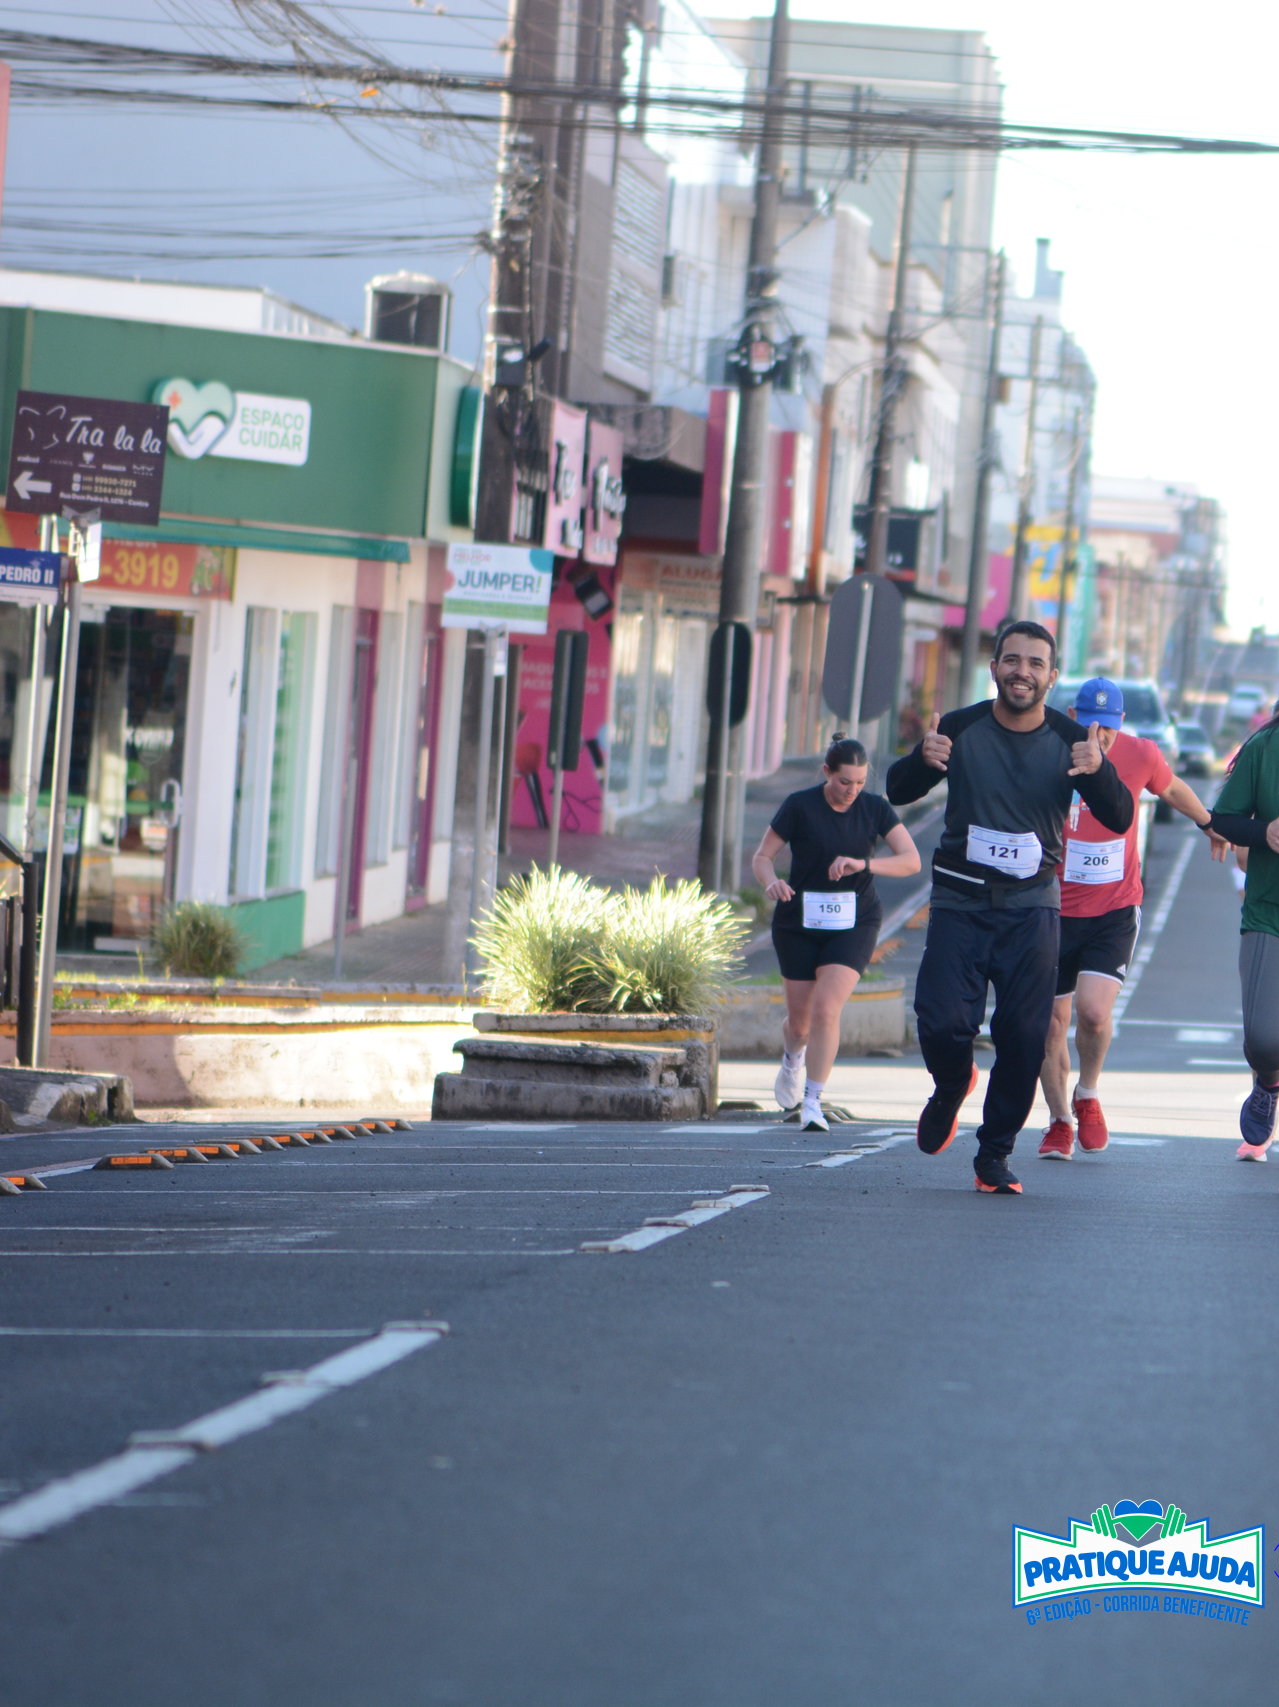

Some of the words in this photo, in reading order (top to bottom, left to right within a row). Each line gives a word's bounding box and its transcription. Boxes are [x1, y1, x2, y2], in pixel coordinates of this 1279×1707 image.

[241, 407, 304, 431] ESPAÇO
[66, 417, 105, 447] Tra
[113, 425, 134, 451] la
[140, 427, 161, 454] la
[239, 428, 303, 451] CUIDAR
[0, 563, 41, 584] PEDRO
[457, 569, 543, 594] JUMPER!
[988, 845, 1019, 859] 121
[1083, 855, 1109, 866] 206
[819, 904, 841, 913] 150
